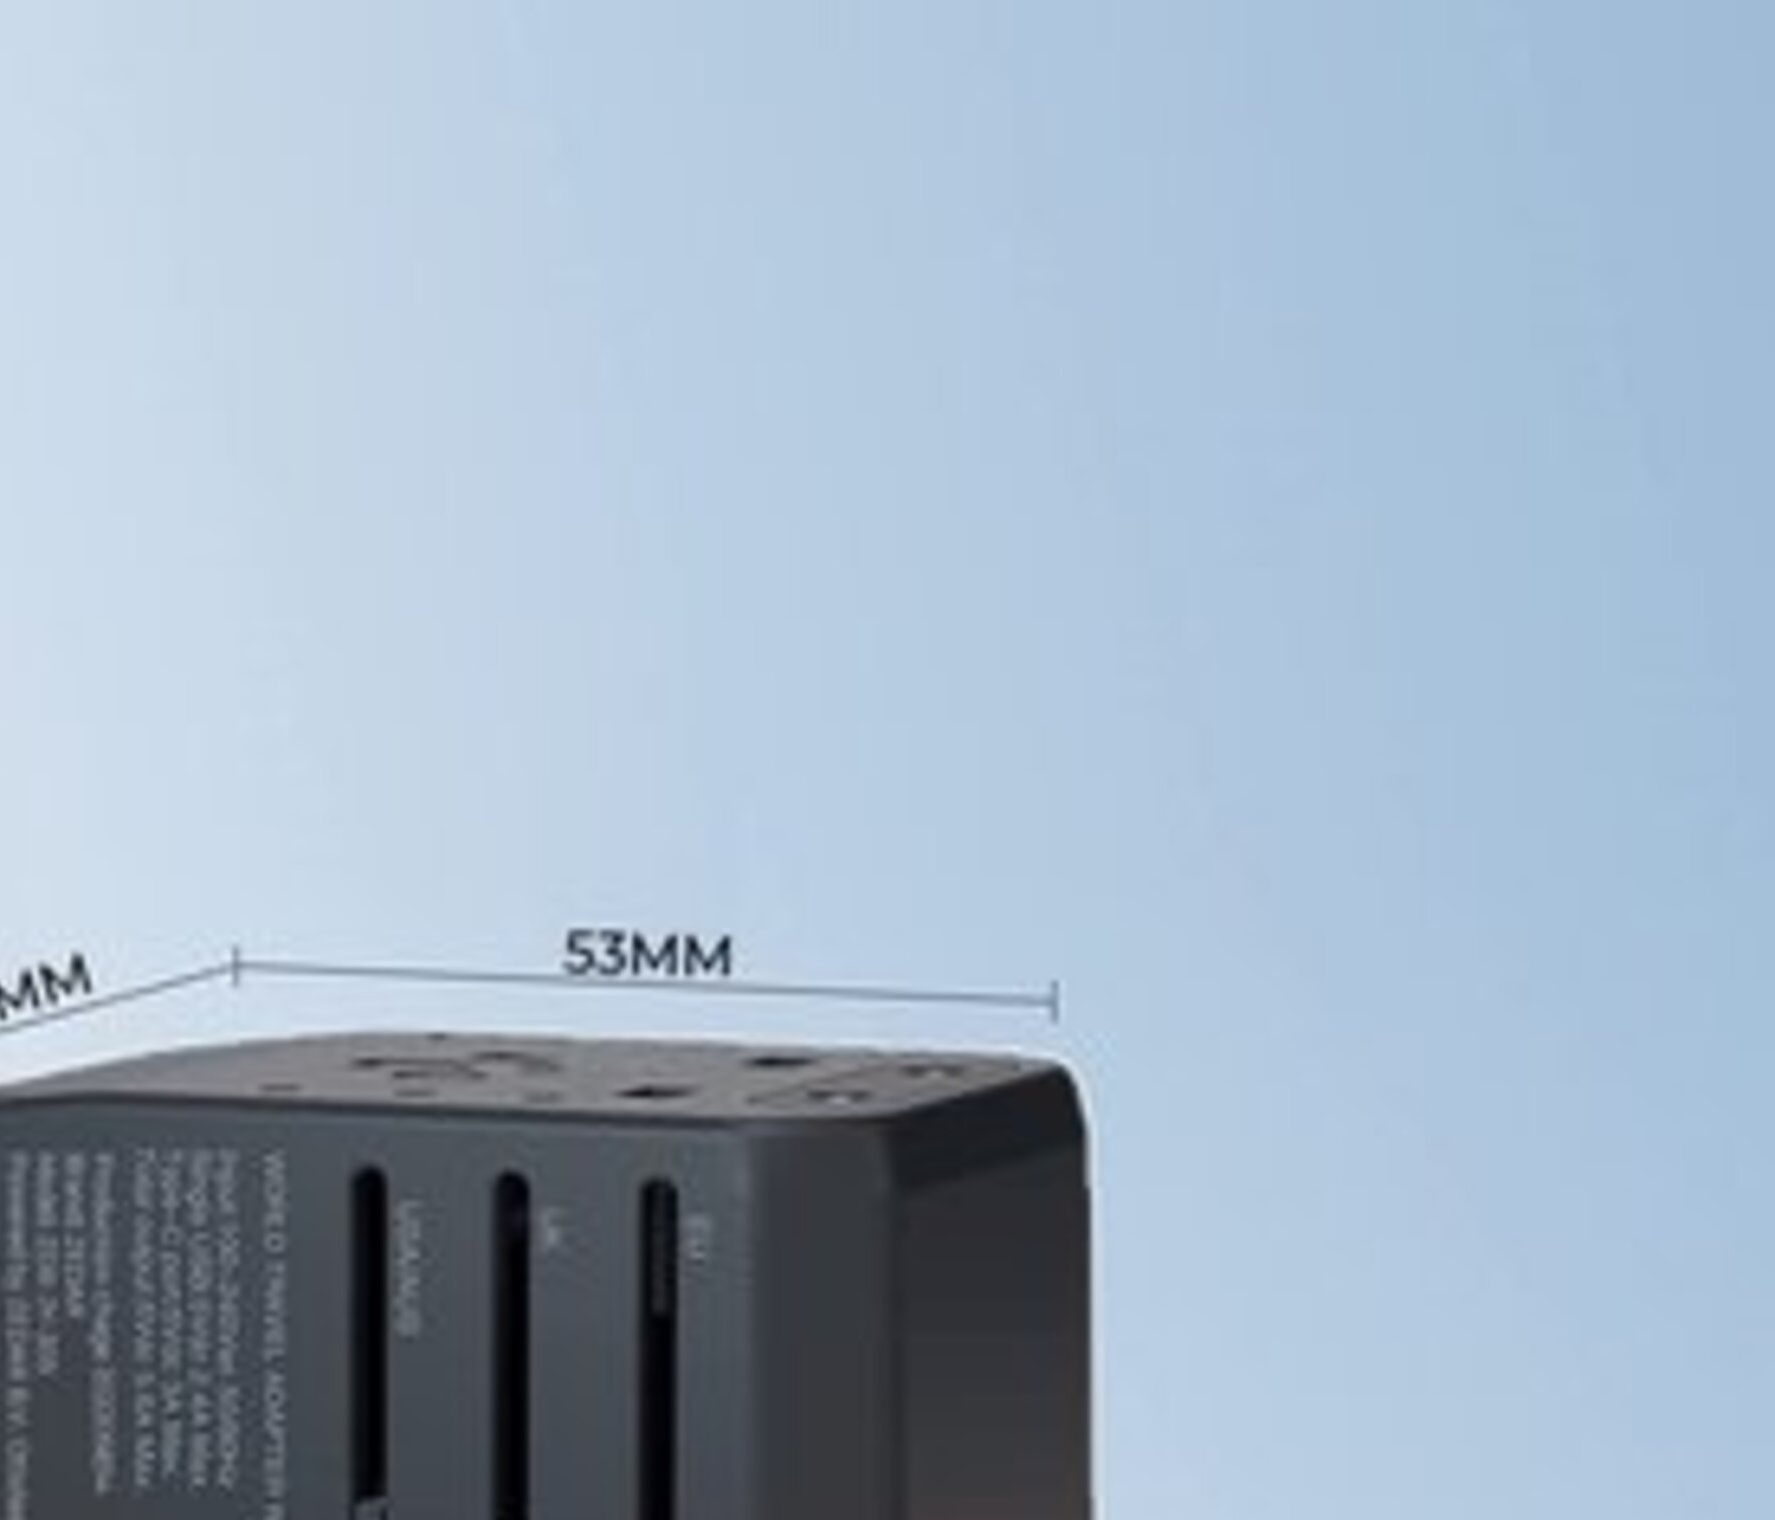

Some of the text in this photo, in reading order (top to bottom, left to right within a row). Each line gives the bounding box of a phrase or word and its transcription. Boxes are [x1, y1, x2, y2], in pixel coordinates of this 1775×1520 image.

[262, 1148, 286, 1254] WORLD
[535, 1205, 565, 1256] UK
[682, 1212, 714, 1261] EU
[262, 1260, 286, 1364] TRAVEL
[262, 1370, 286, 1498] ADAPTER
